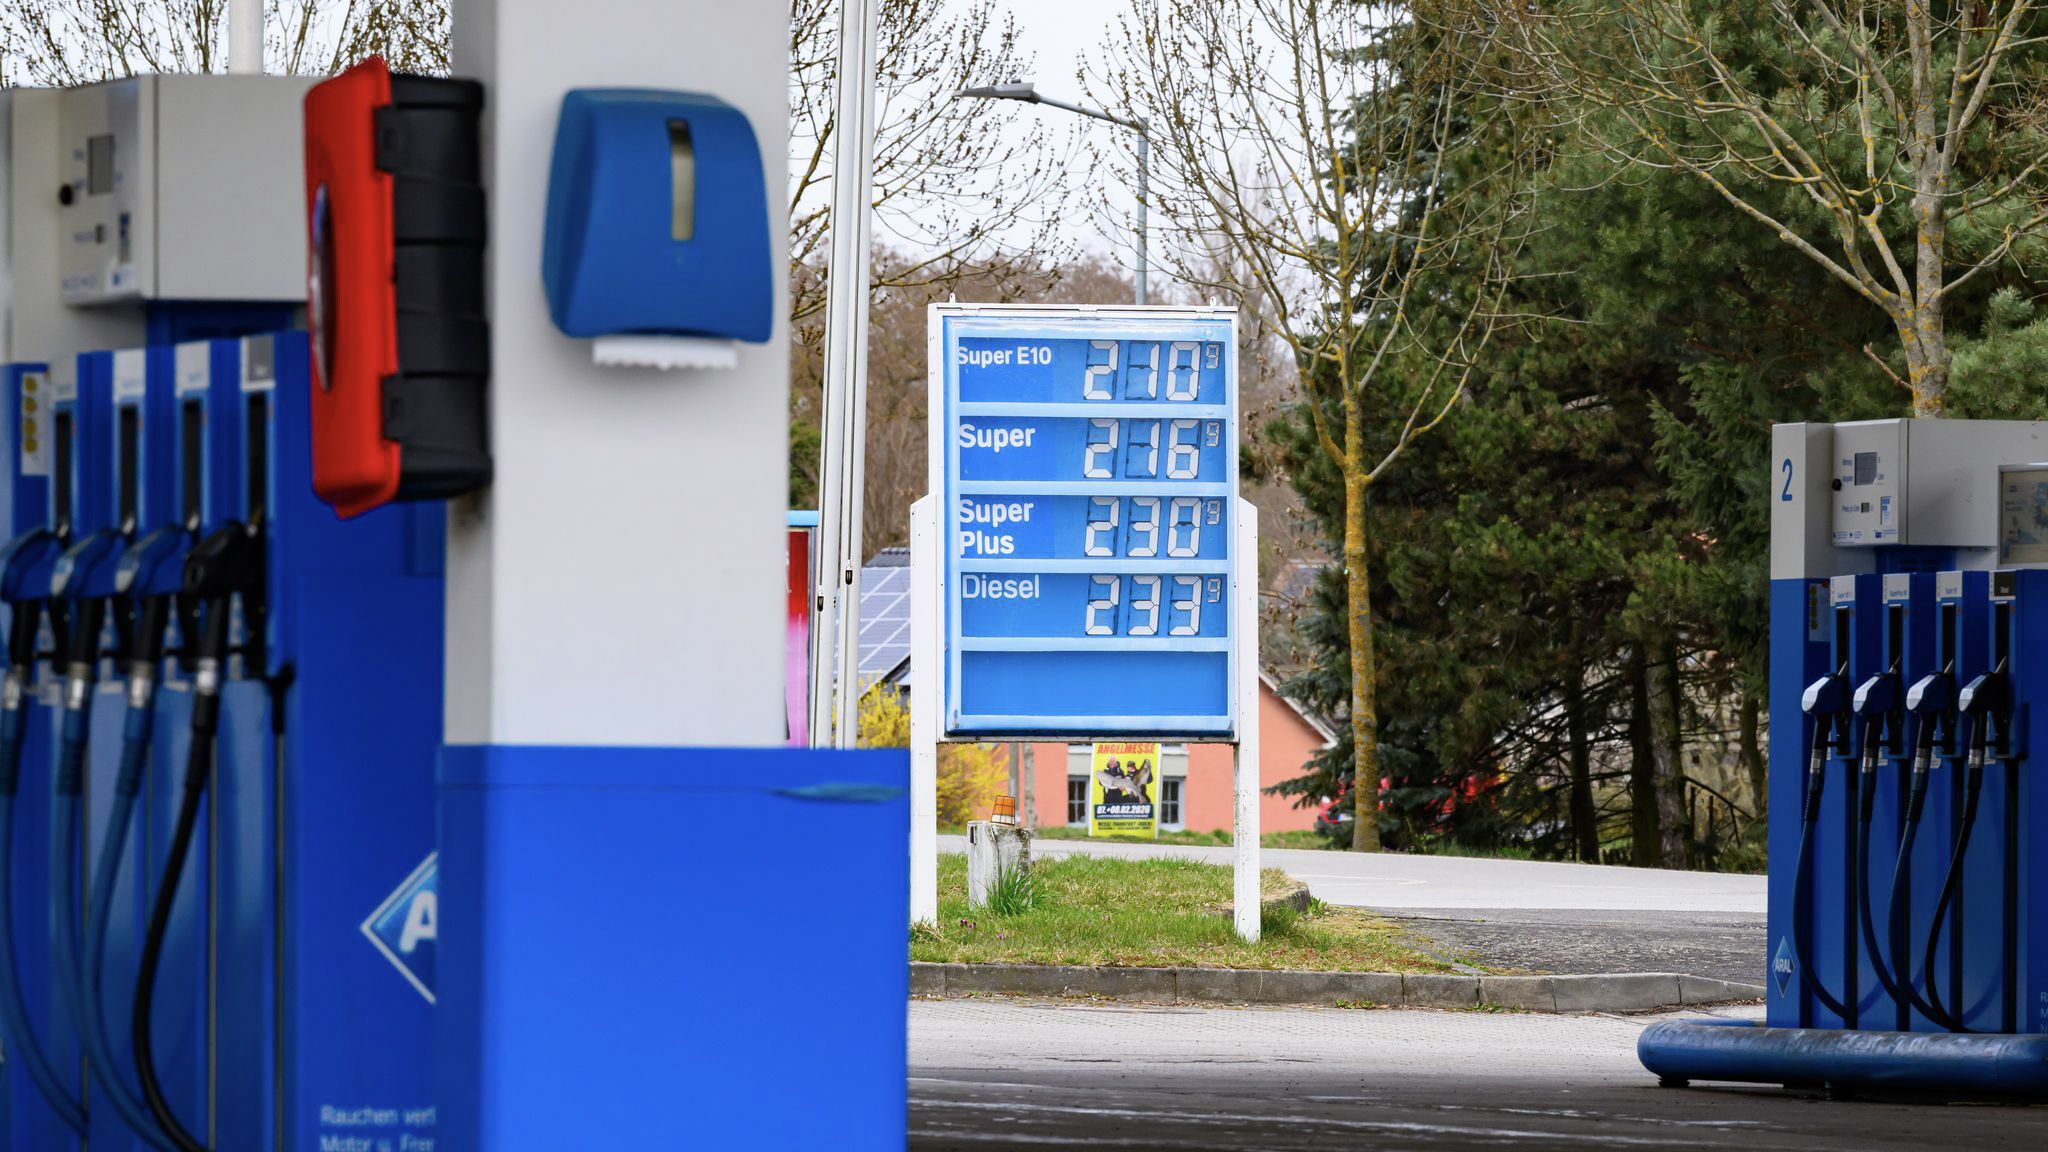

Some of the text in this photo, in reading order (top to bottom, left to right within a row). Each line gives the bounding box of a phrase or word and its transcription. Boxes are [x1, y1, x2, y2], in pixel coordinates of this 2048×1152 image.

[958, 346, 1013, 368] Super
[1017, 346, 1051, 366] E10
[959, 424, 1036, 453] Super
[1781, 458, 1793, 502] 2
[959, 499, 1034, 527] Super
[960, 530, 1015, 555] Plus
[962, 574, 1040, 599] Diesel
[1775, 958, 1791, 973] ARAL
[320, 1104, 398, 1125] Rauchen
